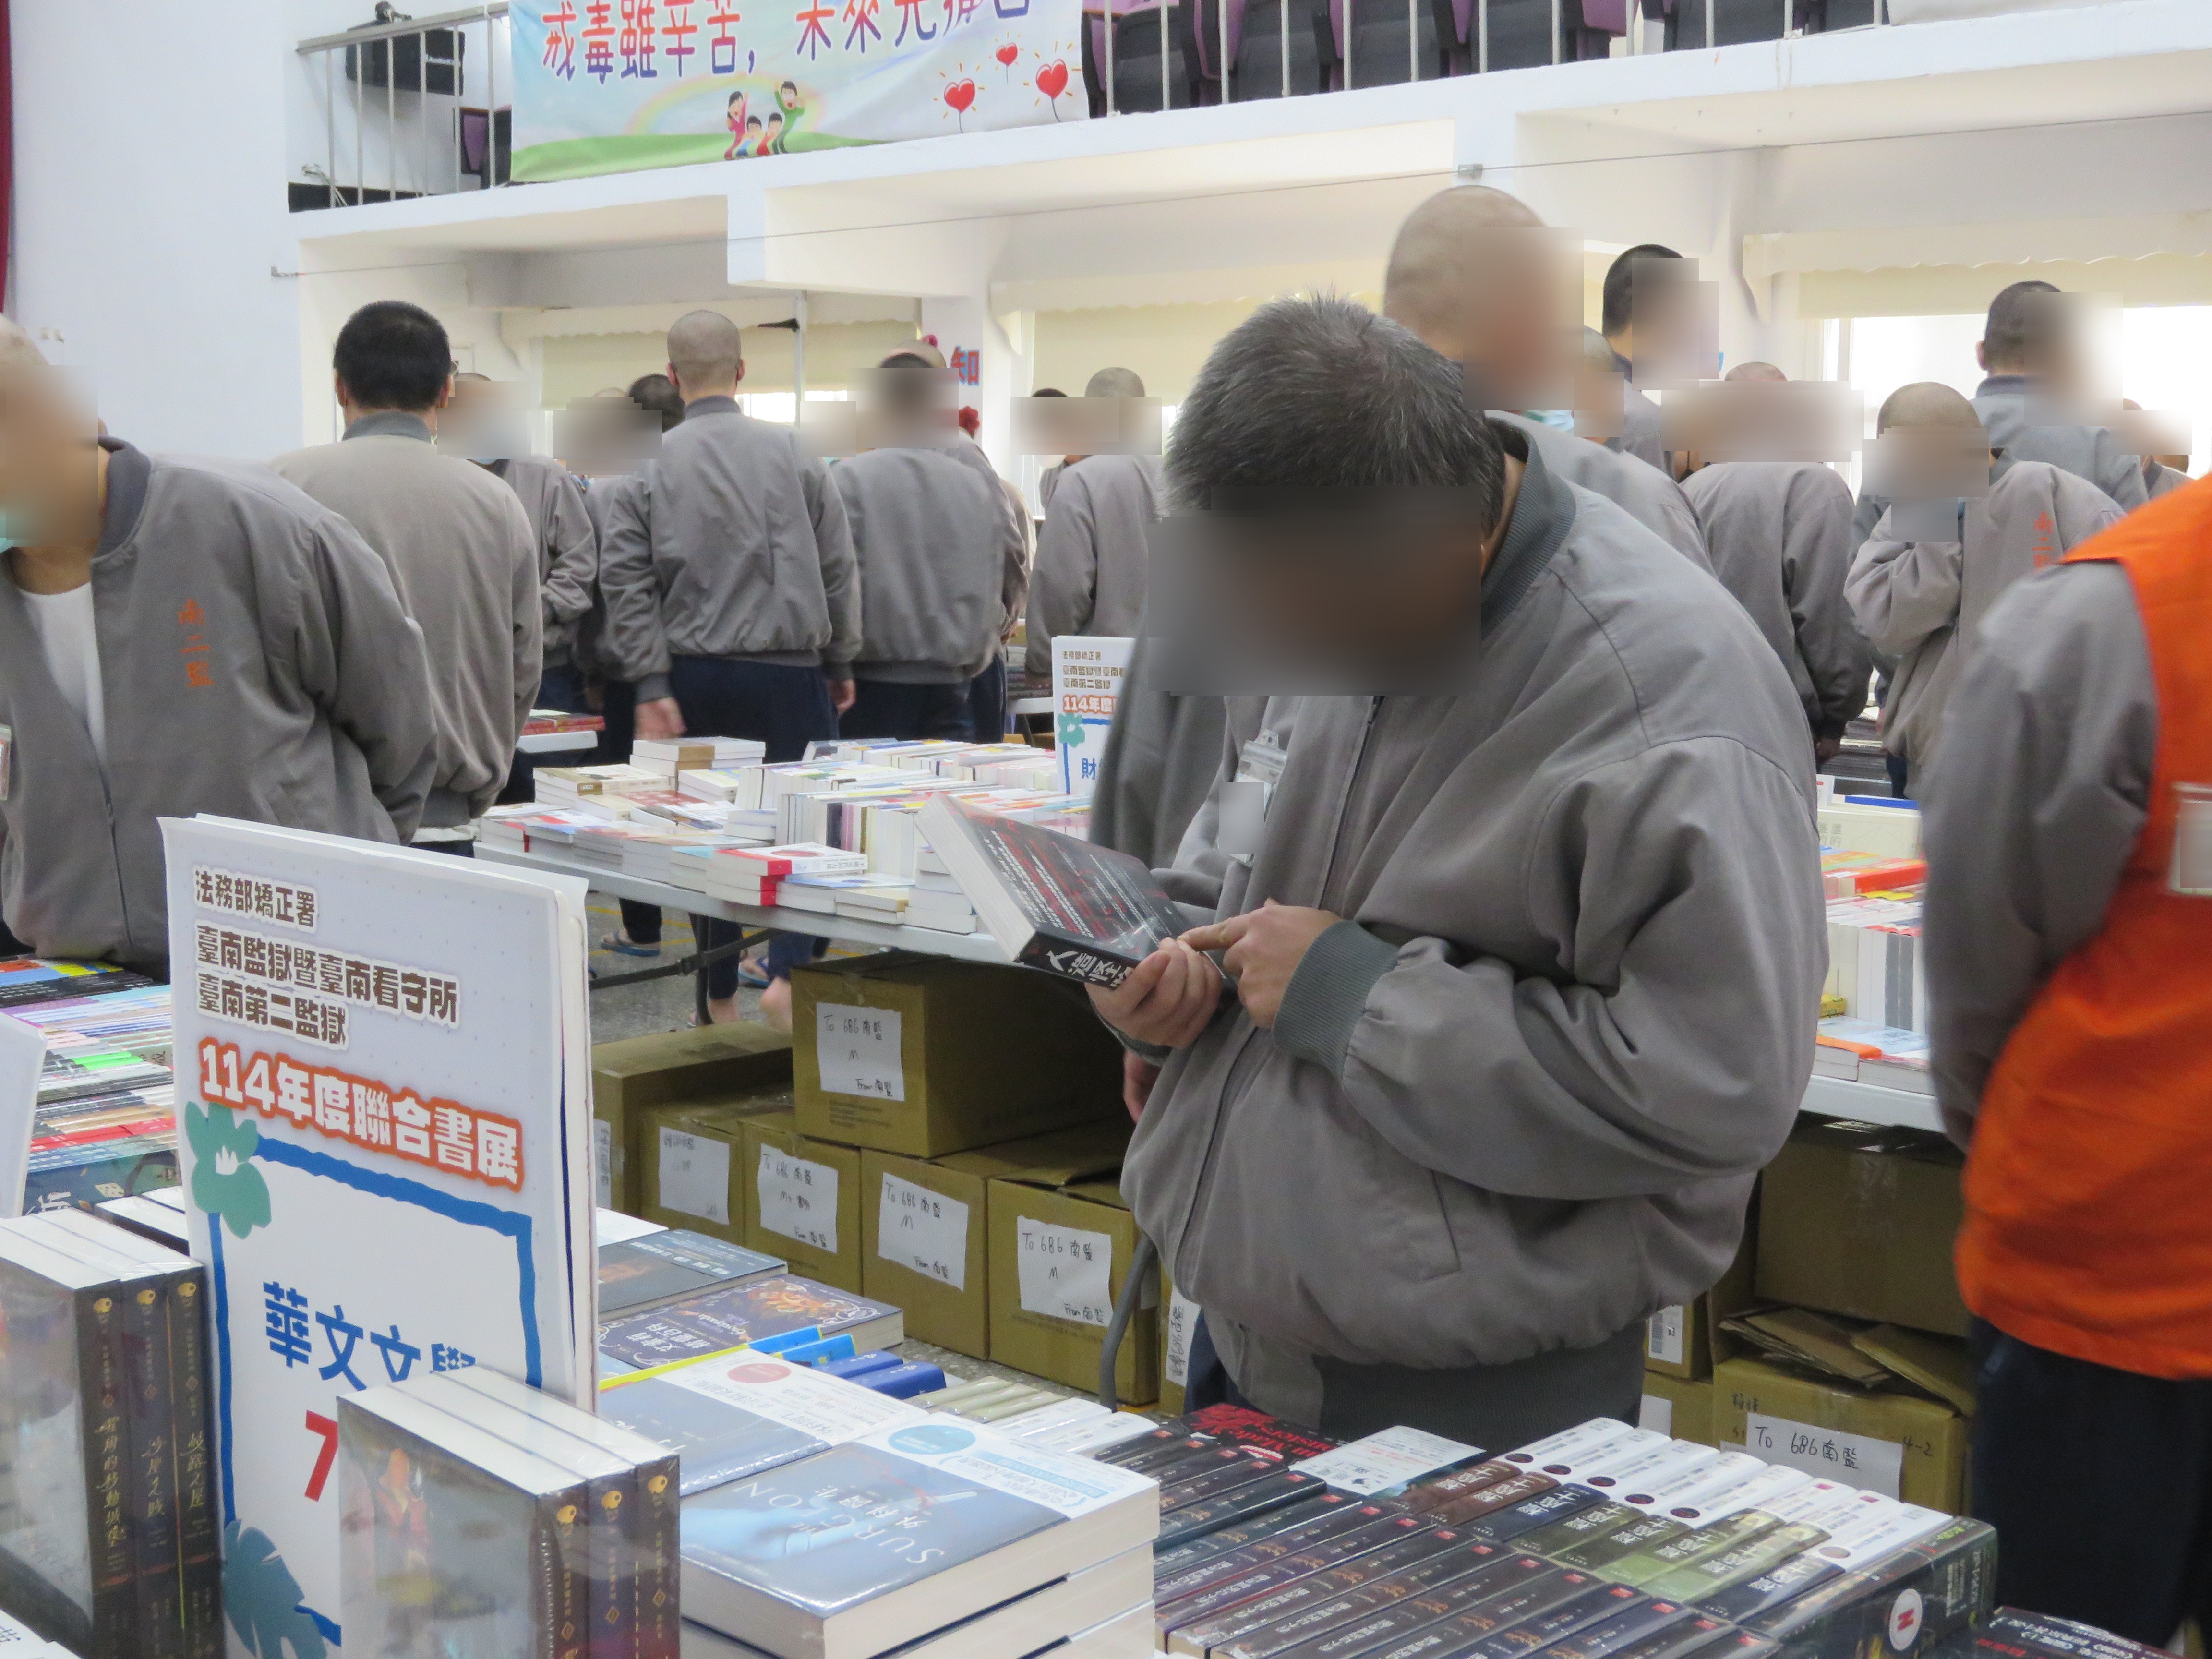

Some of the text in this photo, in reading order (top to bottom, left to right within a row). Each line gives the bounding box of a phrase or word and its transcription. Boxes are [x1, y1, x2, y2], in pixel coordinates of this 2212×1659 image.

[1064, 696, 1117, 713] 114年度
[1082, 758, 1097, 780] 財
[195, 870, 315, 928] 法務部矯正署
[197, 926, 457, 1023] 臺南監獄暨臺南看守所
[199, 973, 346, 1045] 臺南第二監獄
[202, 1043, 520, 1187] 114年度聯合書展
[885, 1182, 896, 1203] To
[1022, 1233, 1034, 1251] To
[1040, 1236, 1063, 1254] 686
[1755, 1426, 1772, 1448] To
